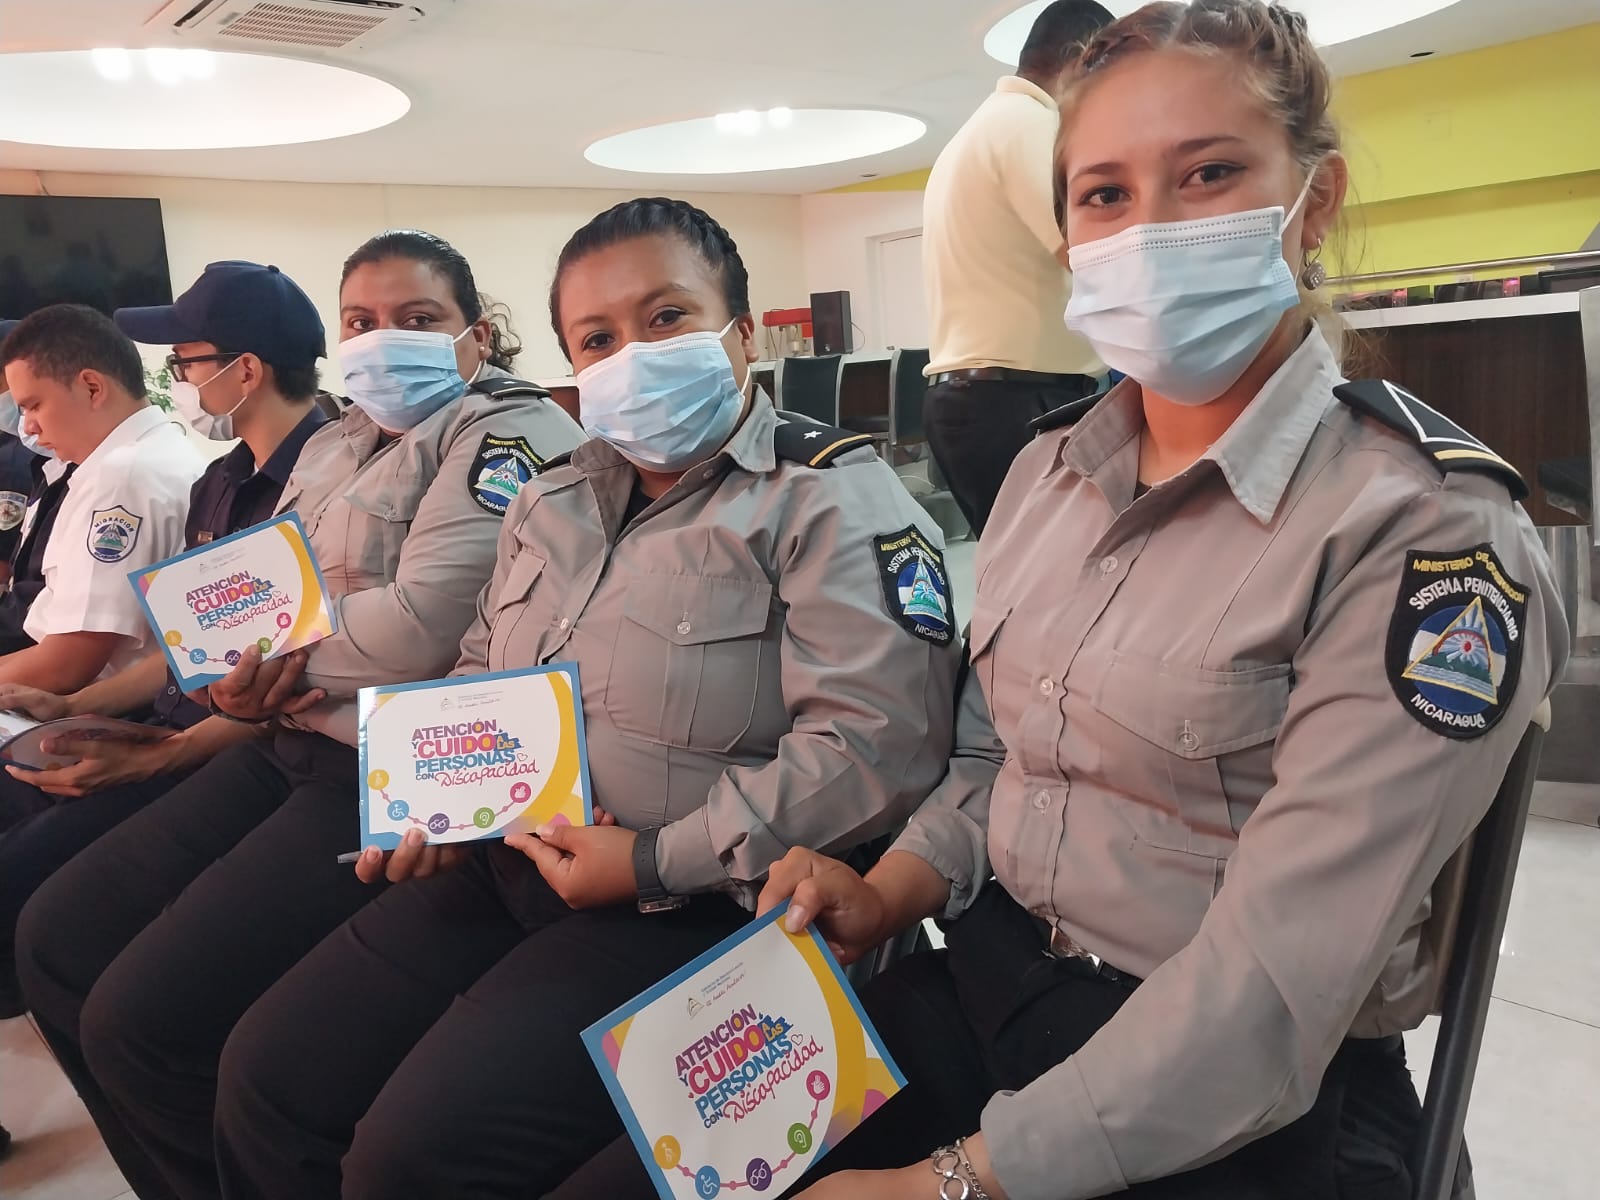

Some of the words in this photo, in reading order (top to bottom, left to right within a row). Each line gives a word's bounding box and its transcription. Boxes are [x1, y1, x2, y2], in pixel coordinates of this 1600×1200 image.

[482, 446, 508, 459] SISTEMA
[887, 548, 912, 574] SISTEMA
[1413, 556, 1474, 573] MINISTERIO
[185, 570, 250, 603] ATENCIÓN
[193, 582, 254, 614] CUIDO
[196, 590, 273, 626] PERSONAS
[215, 593, 293, 631] Discapacidad
[1409, 578, 1464, 611] SISTEMA
[1464, 576, 1519, 641] PENITENCIARIO
[1410, 693, 1487, 729] NICARAGUA
[411, 718, 497, 742] ATENCIÓN
[411, 741, 419, 750] Y
[418, 733, 496, 759] CUIDO
[415, 749, 516, 774] PERSONAS
[415, 772, 435, 781] CON
[434, 759, 540, 787] Discapacidad
[674, 1003, 757, 1077] ATENCIÓN
[679, 1074, 689, 1087] Y
[688, 1024, 765, 1095] CUIDO
[694, 1031, 793, 1120] PERSONAS
[703, 1108, 724, 1129] CON
[723, 1034, 824, 1123] Discapacidad
